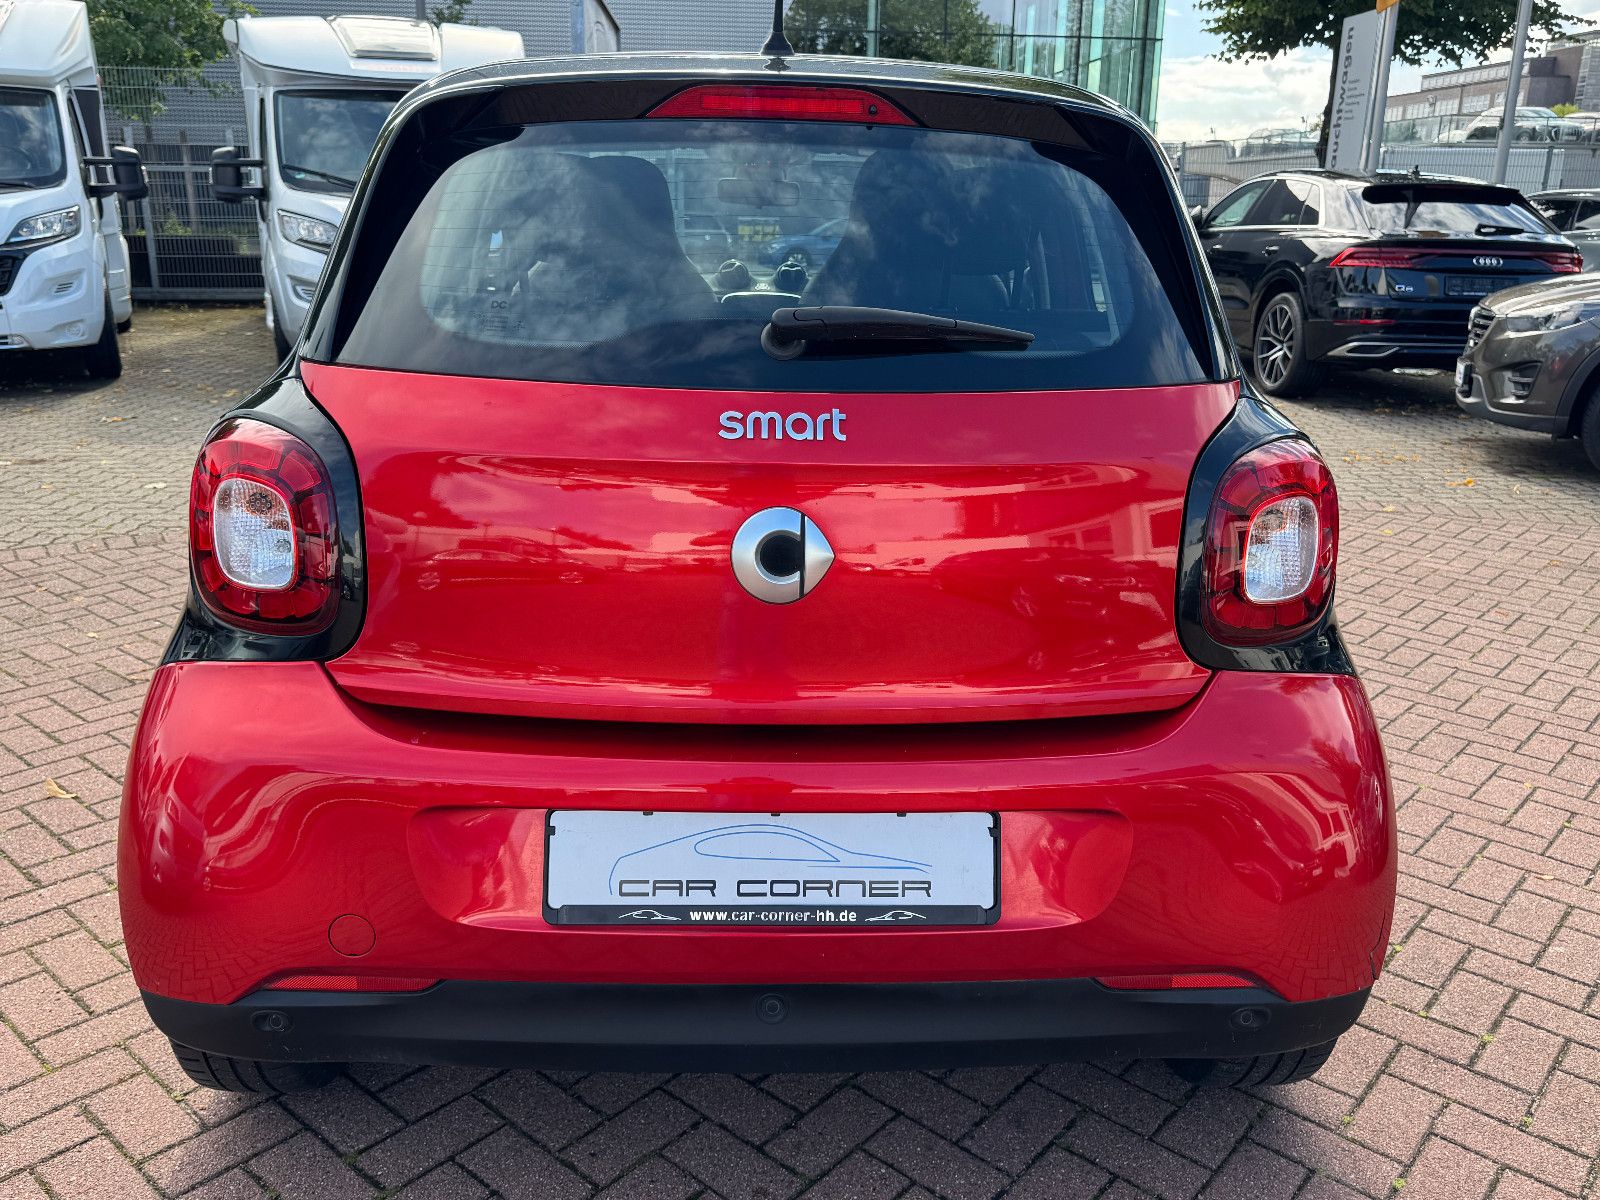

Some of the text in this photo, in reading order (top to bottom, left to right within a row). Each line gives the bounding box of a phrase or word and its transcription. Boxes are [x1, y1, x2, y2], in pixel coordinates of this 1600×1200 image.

[718, 408, 847, 442] smart
[618, 879, 932, 898] CAR CORNER
[689, 909, 857, 922] www.car-corner-hh.de
